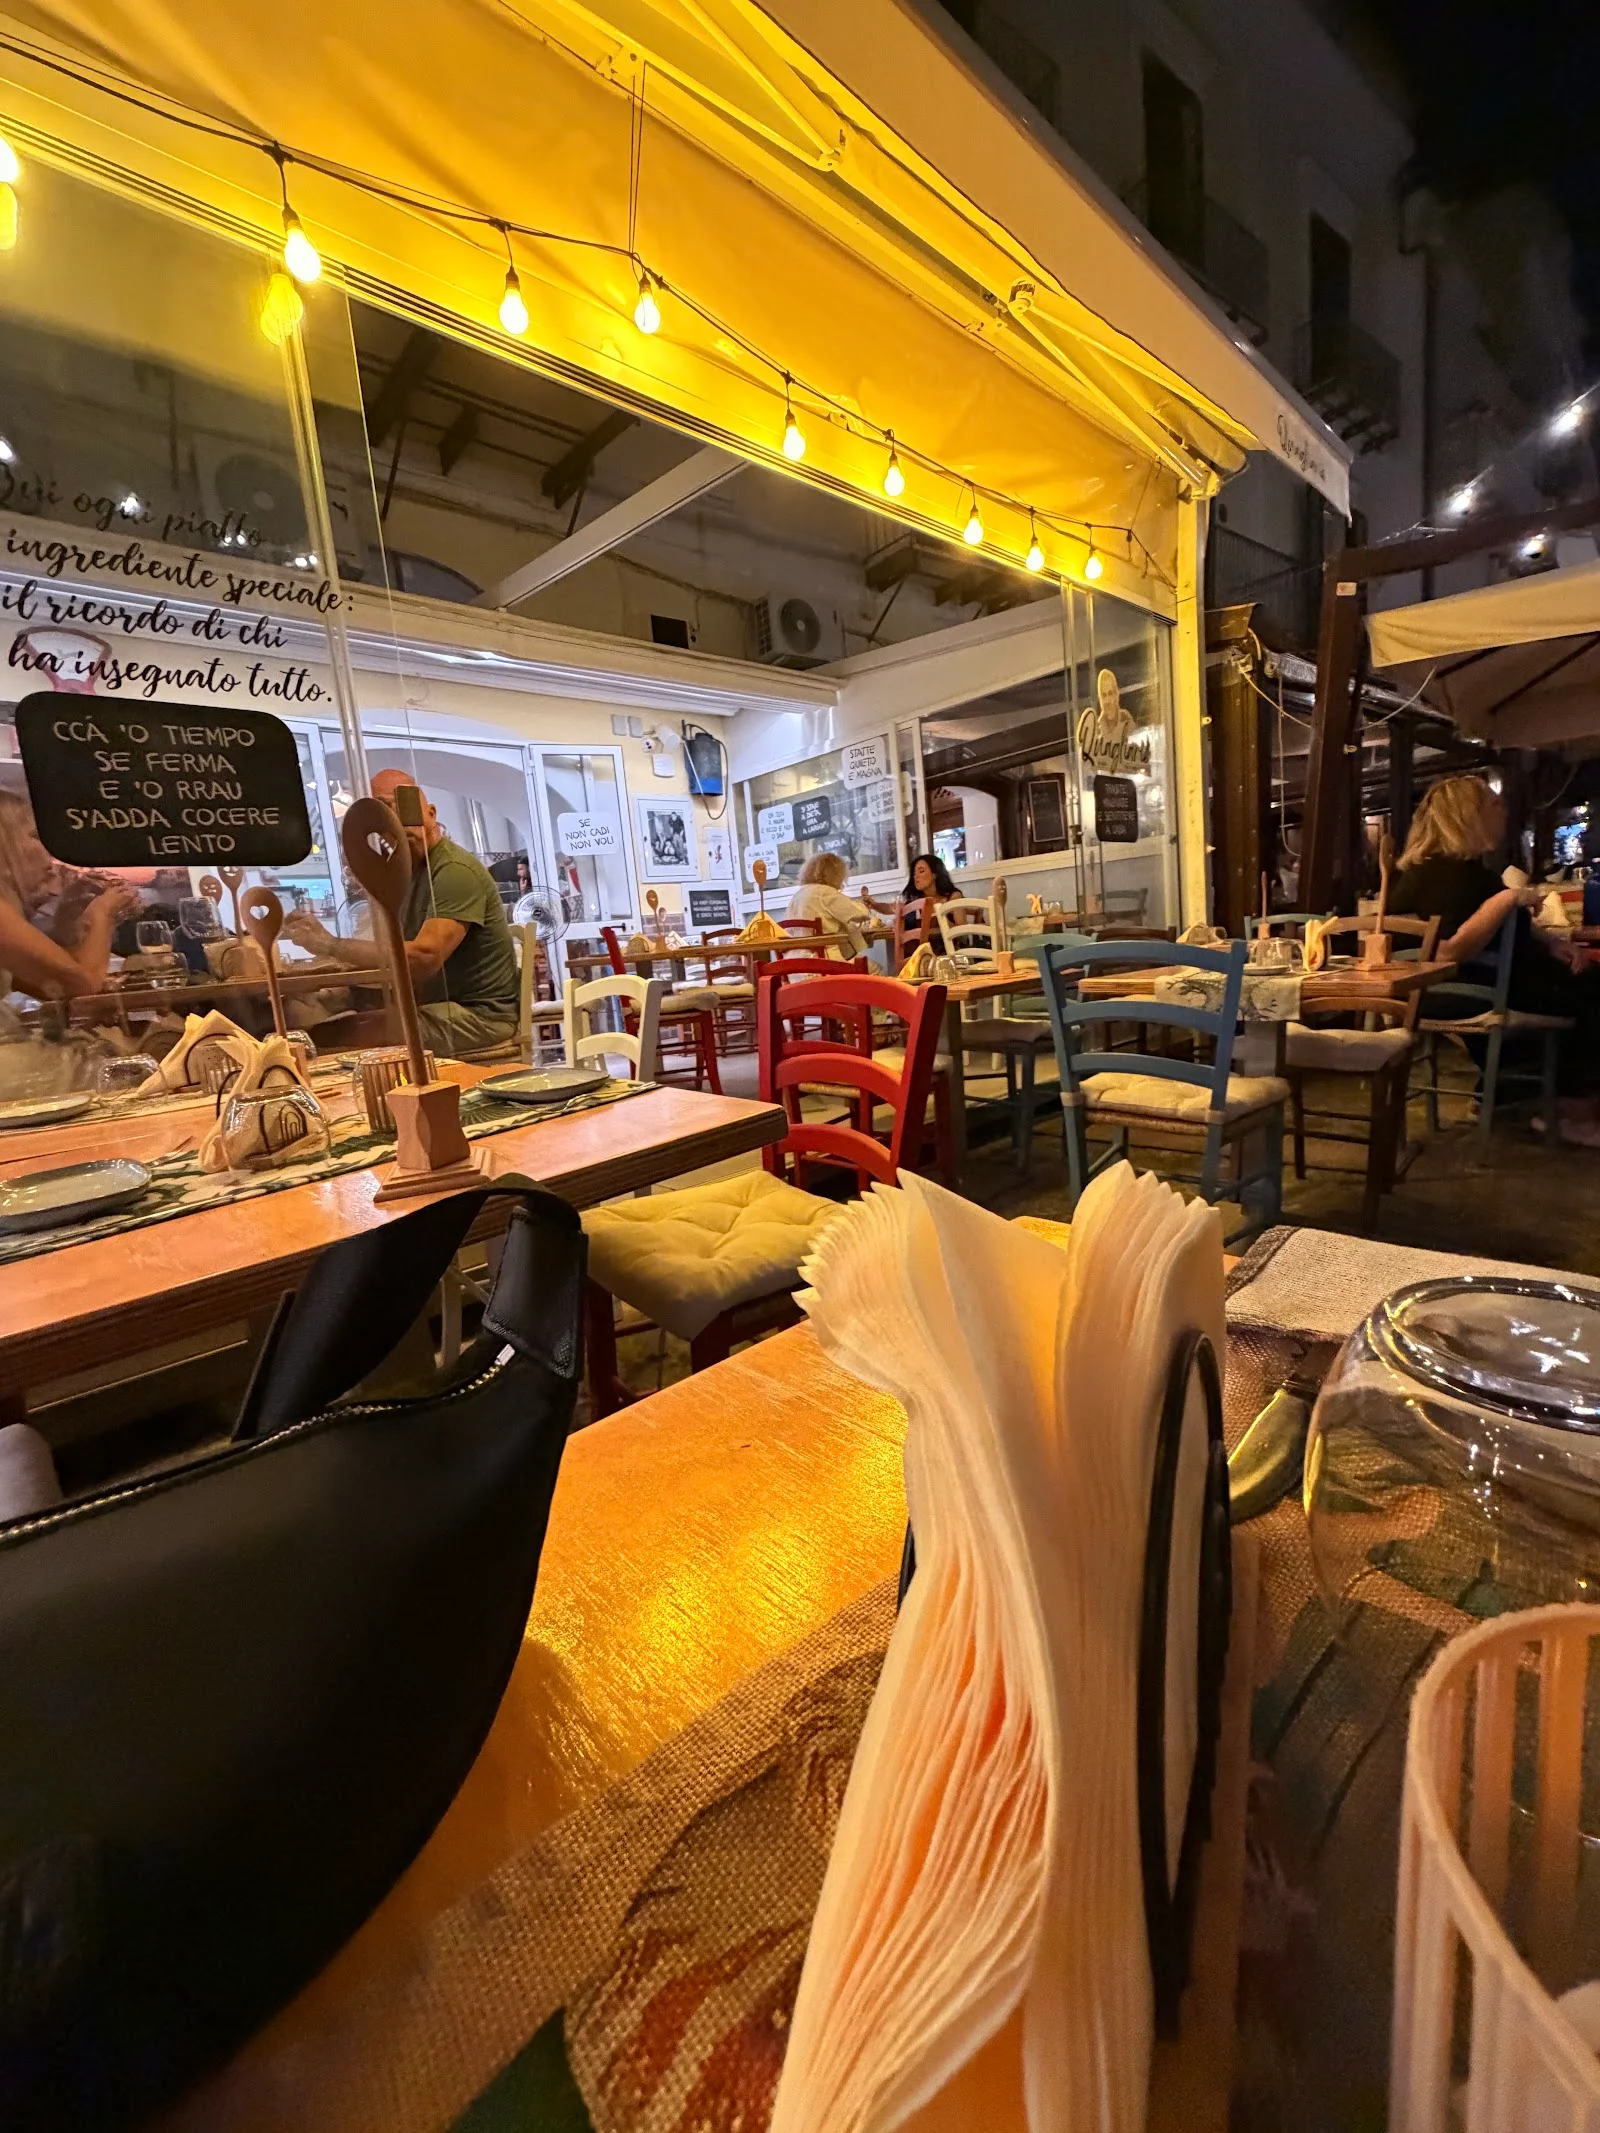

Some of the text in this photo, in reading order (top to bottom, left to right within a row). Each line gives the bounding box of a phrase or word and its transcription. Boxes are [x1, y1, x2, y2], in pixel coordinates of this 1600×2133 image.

[7, 529, 354, 613] ingrediente speciale:
[2, 579, 288, 649] il ricordo di chi
[9, 634, 332, 703] ha insegnato tutto.
[162, 724, 256, 748] TIEMPO
[849, 744, 876, 759] STATTE
[94, 751, 237, 775] SE FERMA
[848, 772, 854, 781] E
[99, 780, 120, 800] E
[175, 780, 243, 801] RRAU
[66, 807, 280, 830] S'ADDA COCERE
[578, 818, 590, 828] SE
[565, 826, 610, 840] NON CADI
[570, 835, 614, 850] NON VOLI
[149, 834, 236, 855] LENTO
